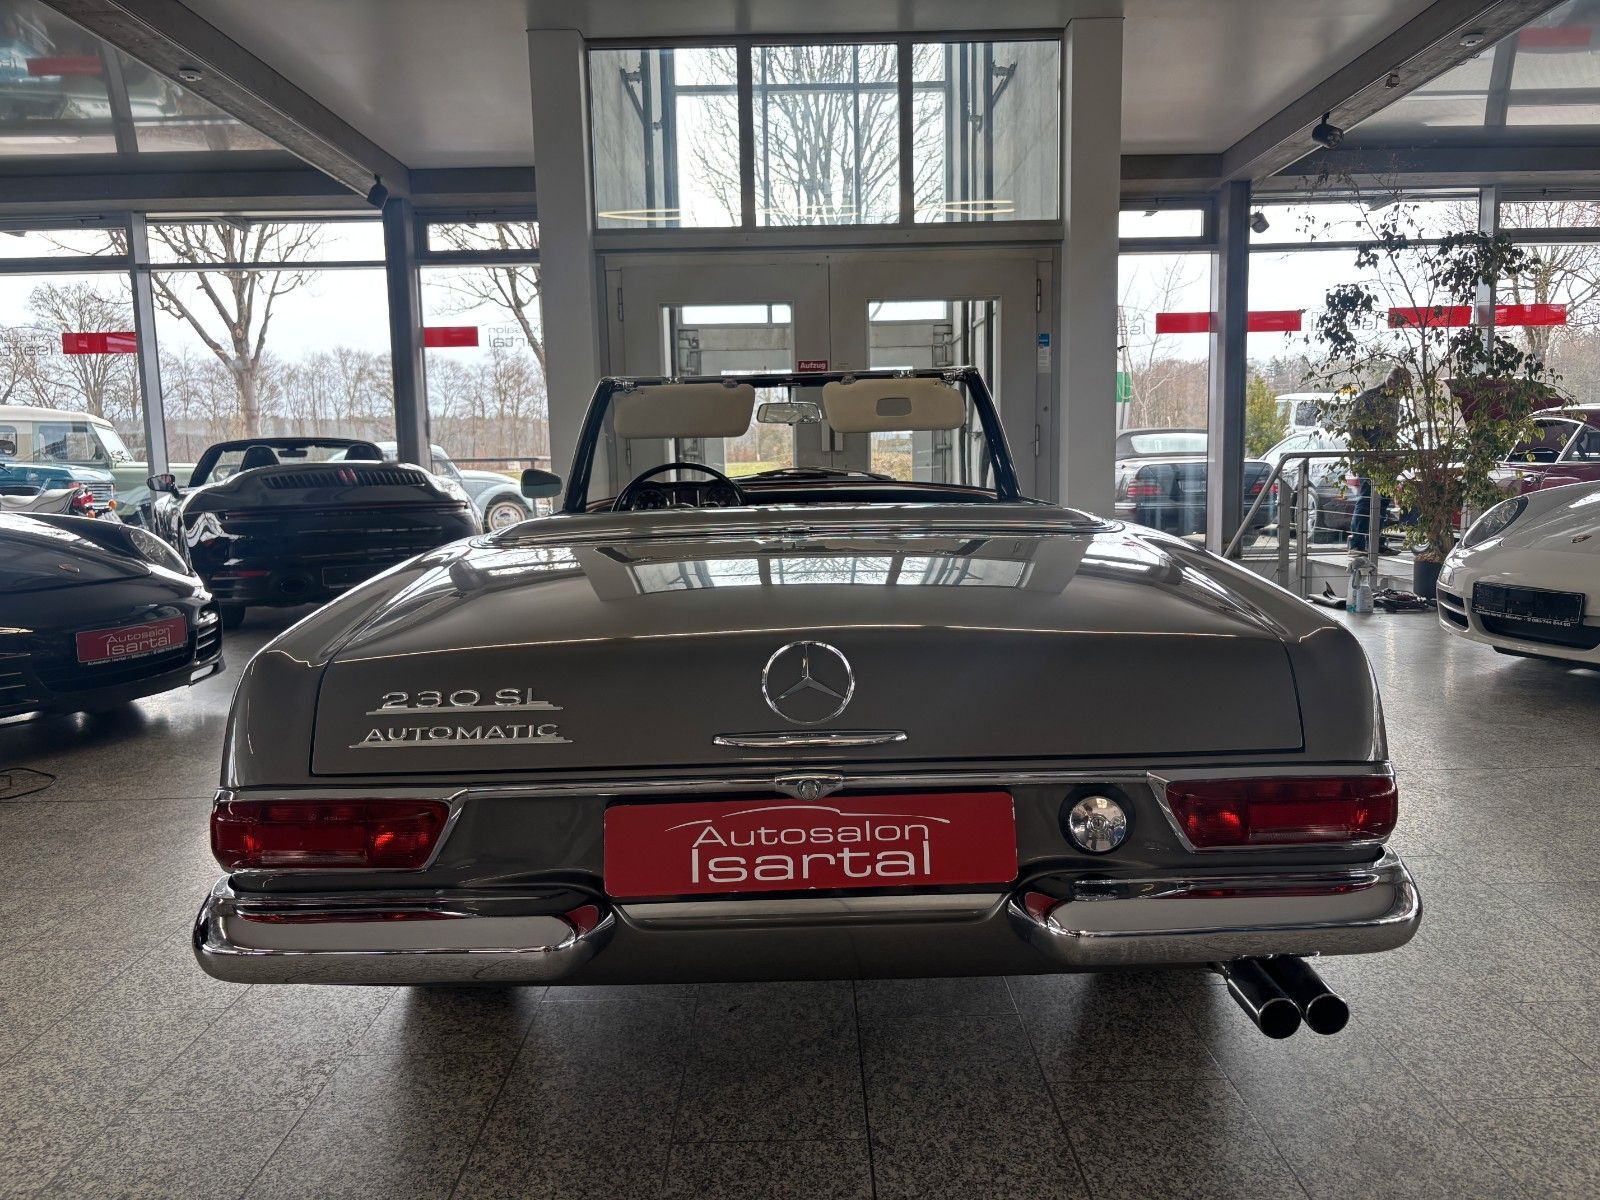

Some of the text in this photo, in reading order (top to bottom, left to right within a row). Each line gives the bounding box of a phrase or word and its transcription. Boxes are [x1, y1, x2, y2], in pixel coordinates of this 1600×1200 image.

[800, 361, 826, 369] Aufzug
[106, 630, 171, 656] Isartal
[107, 627, 170, 643] Autosalon
[382, 687, 549, 709] 230 SL
[364, 723, 559, 743] AUTOMATIC
[692, 820, 930, 848] Autosalon
[691, 840, 931, 884] Isartal
